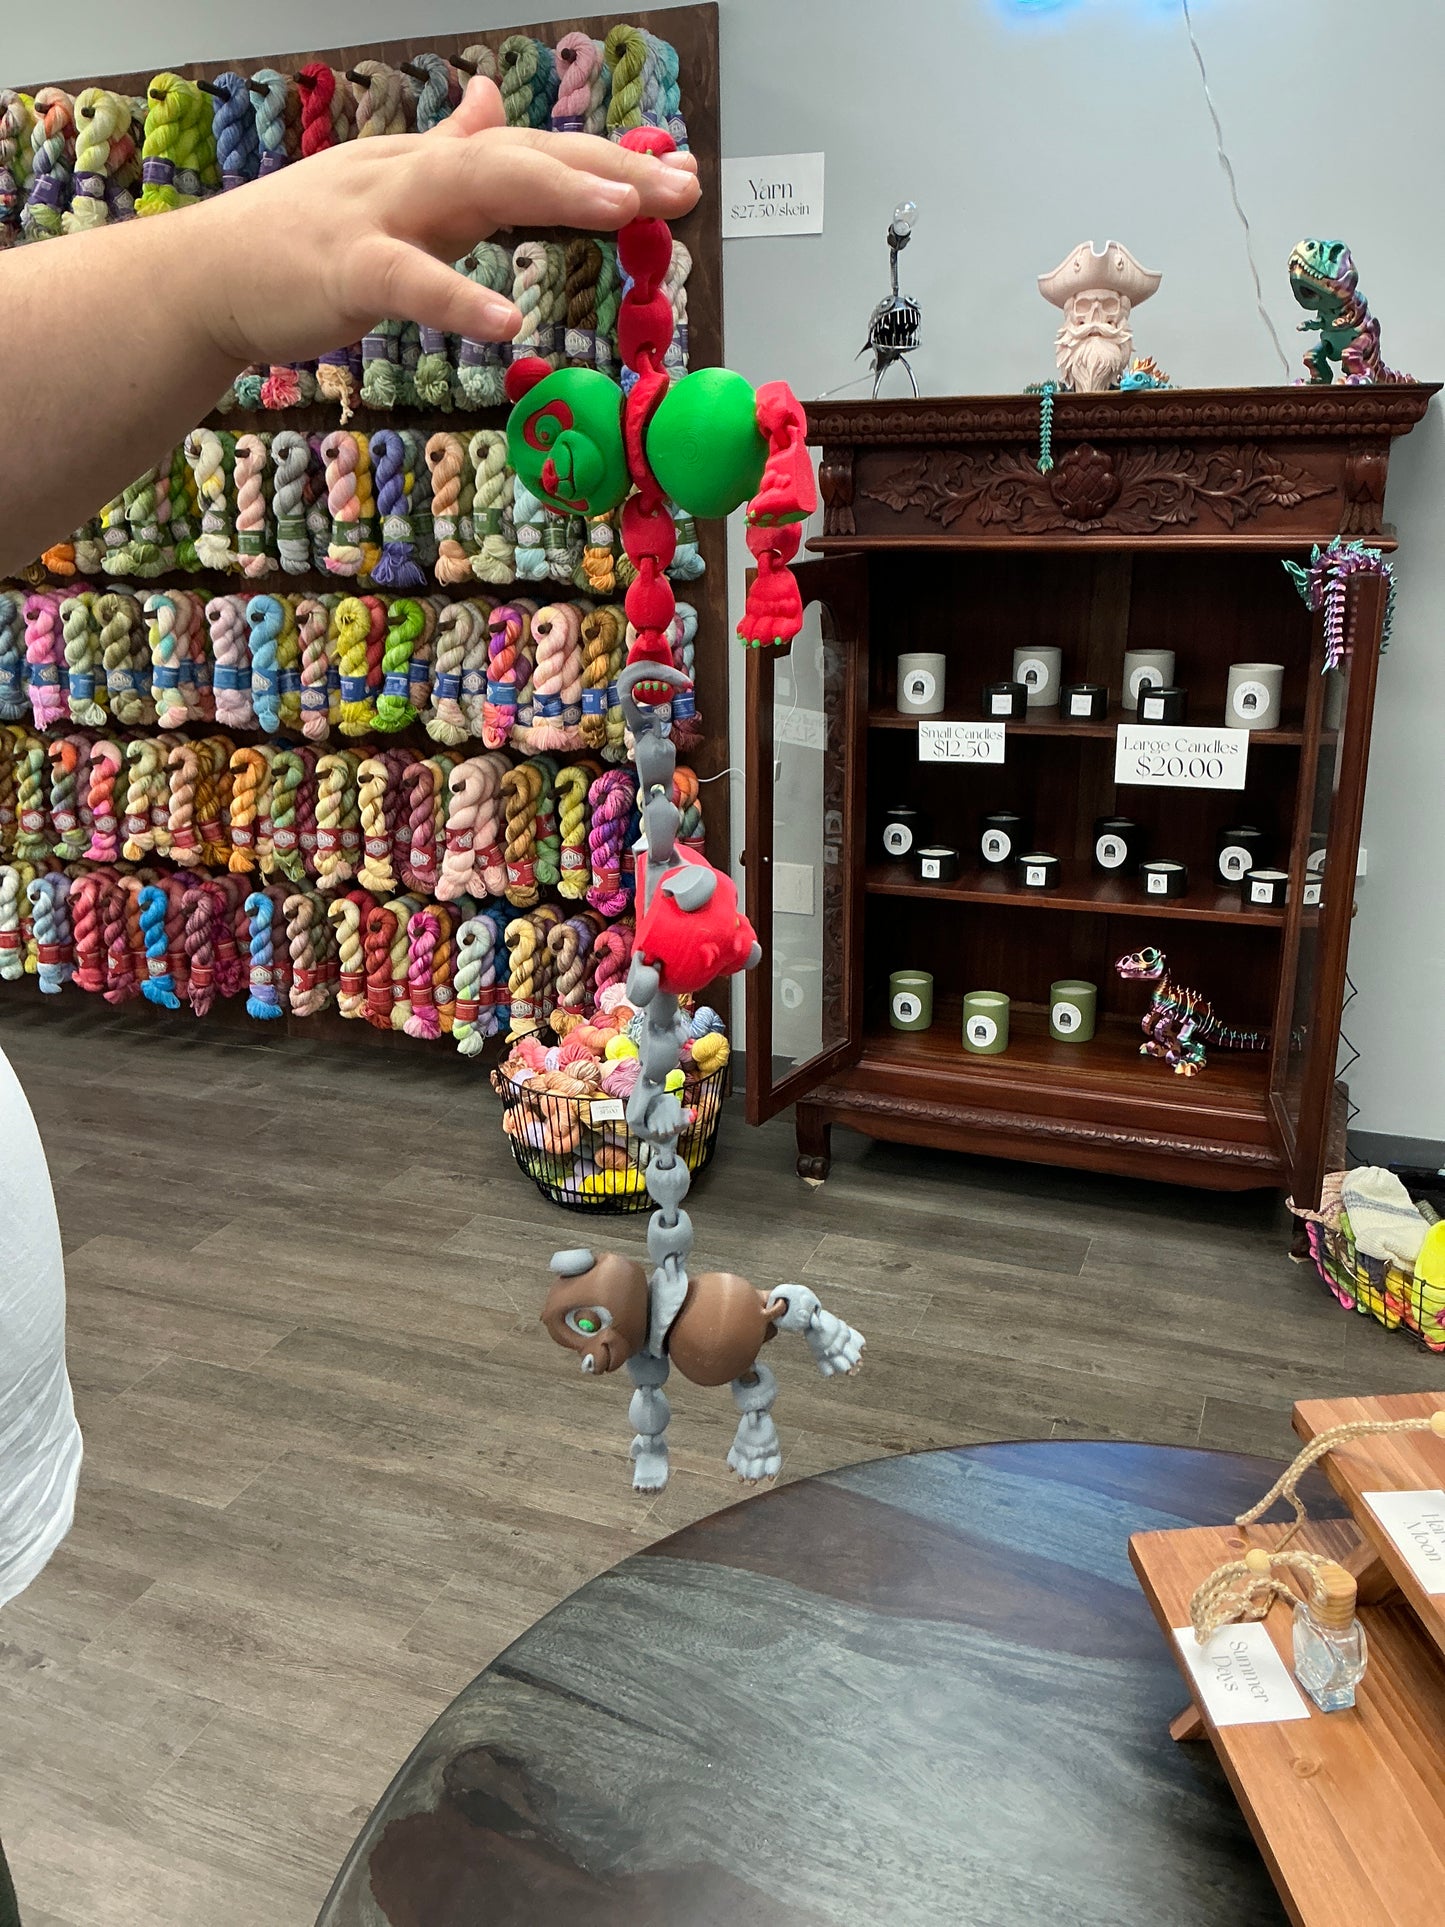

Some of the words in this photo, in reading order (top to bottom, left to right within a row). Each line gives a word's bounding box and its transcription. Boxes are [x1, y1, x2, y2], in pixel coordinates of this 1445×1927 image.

[748, 178, 793, 200] Yarn
[730, 202, 810, 220] $27.50/skein
[921, 726, 952, 739] Small
[955, 727, 1003, 740] Candles
[933, 738, 990, 758] $12.50
[1124, 736, 1170, 754] Large
[1175, 738, 1239, 755] Candles
[1135, 752, 1223, 779] $20.00
[1402, 1520, 1441, 1561] Moon
[1211, 1655, 1238, 1691] Days
[1229, 1641, 1269, 1703] Summer
